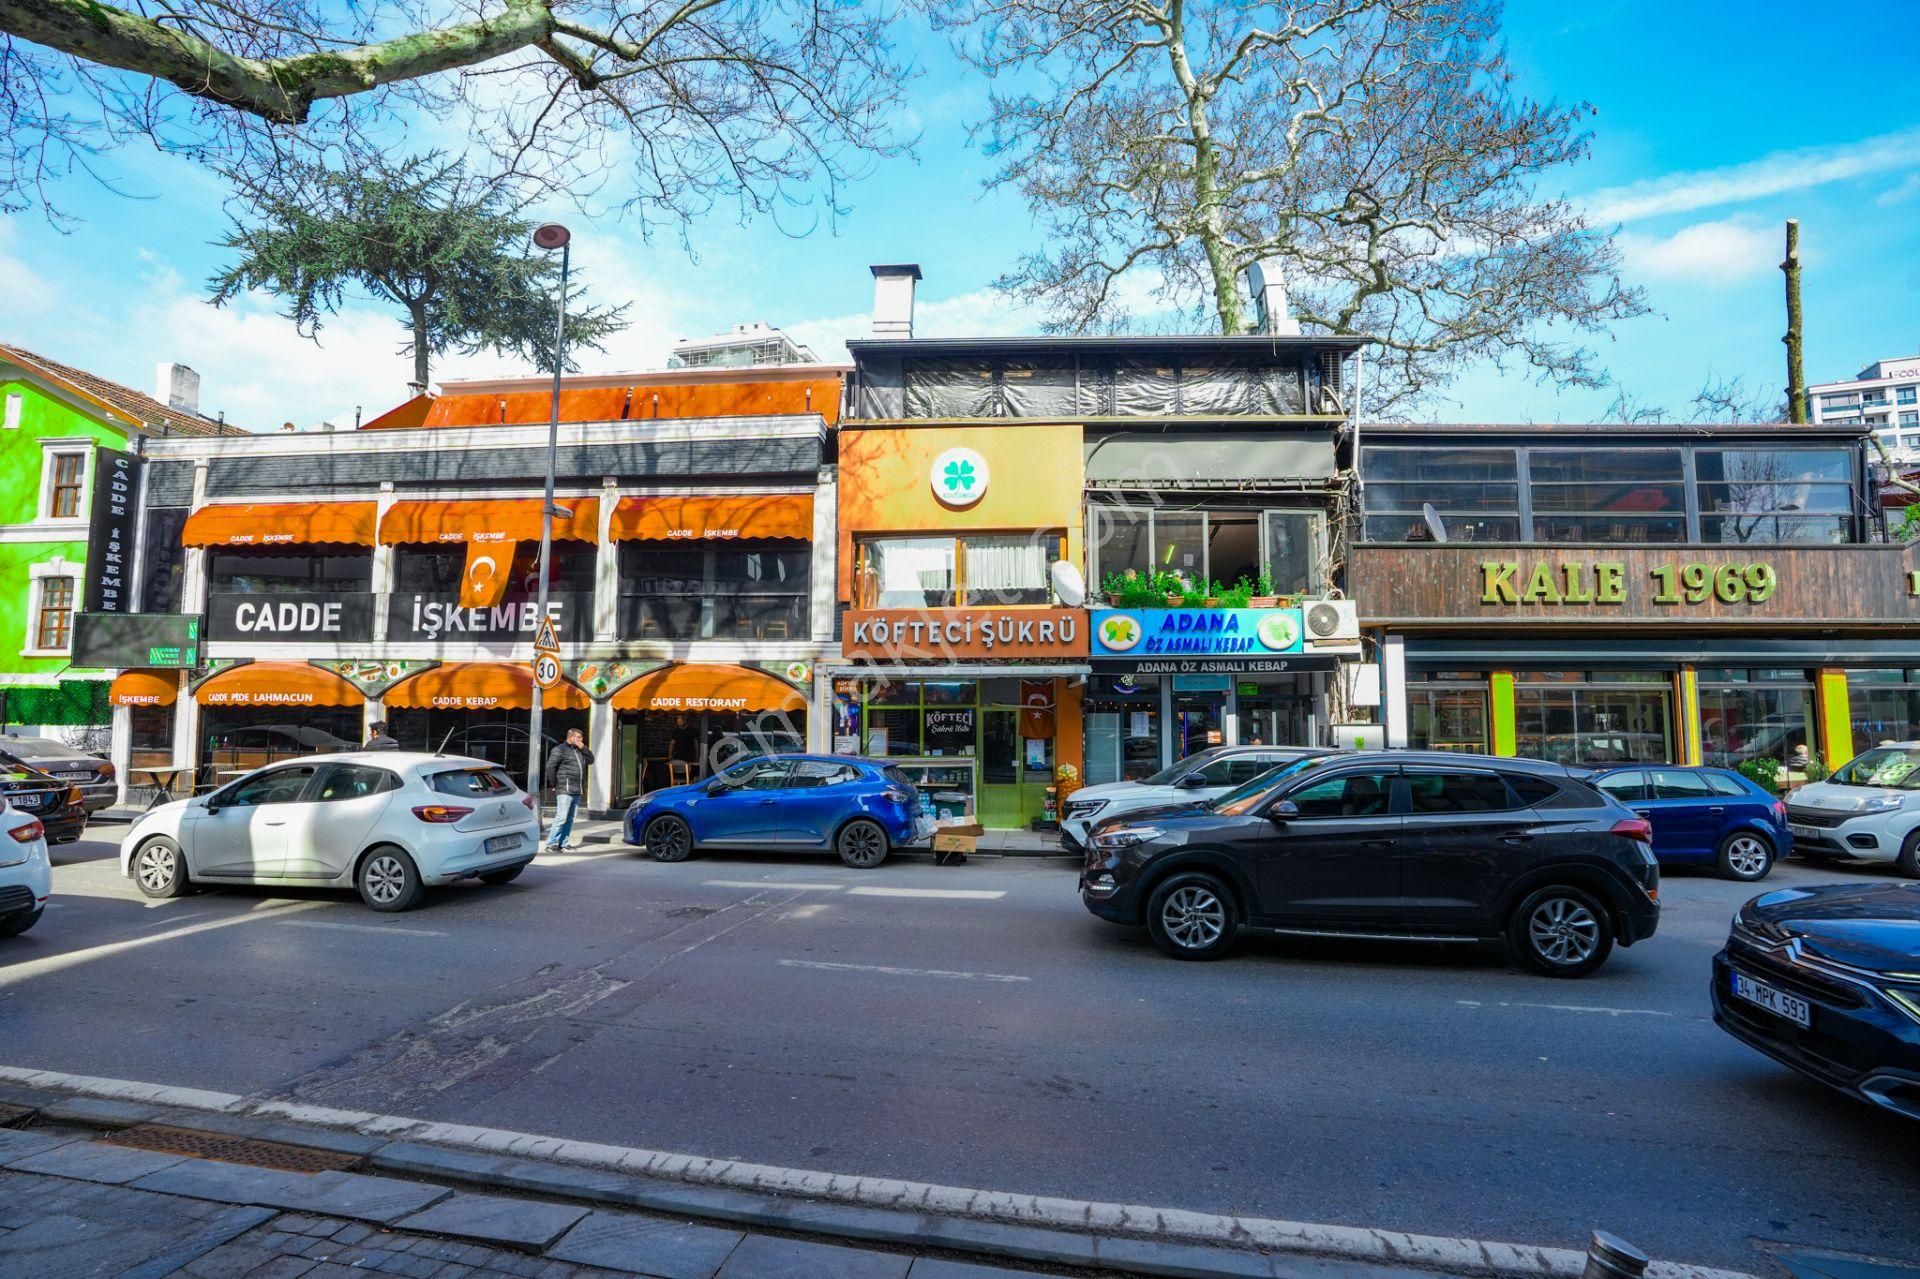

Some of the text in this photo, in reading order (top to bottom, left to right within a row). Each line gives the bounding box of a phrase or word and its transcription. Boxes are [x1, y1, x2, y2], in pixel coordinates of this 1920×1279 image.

[111, 458, 128, 515] CADDE
[666, 527, 739, 538] CADDE İŞKEMBE
[101, 527, 122, 611] İŞKEMBE
[1480, 561, 1777, 604] KALE 1969
[235, 602, 342, 632] CADDE
[411, 595, 563, 640] İŞKEMBE
[1160, 613, 1240, 633] ADANA
[853, 615, 1076, 648] KÖFTECİ ŞÜKRÜ
[1145, 635, 1255, 653] ÖZ ASMALI KEBAP
[538, 662, 556, 679] 30
[1137, 659, 1288, 672] ADANA ÖZ ASMALI KEBAP
[118, 693, 160, 703] İŞKEMBE
[208, 693, 228, 702] CADDE
[253, 693, 313, 702] LAHMACUN
[432, 696, 498, 706] CADDE KEBAP
[650, 697, 747, 707] CADDE RESTORANT
[926, 710, 973, 728] KÖFTECİ
[1737, 976, 1807, 1021] 34 MPK 593
